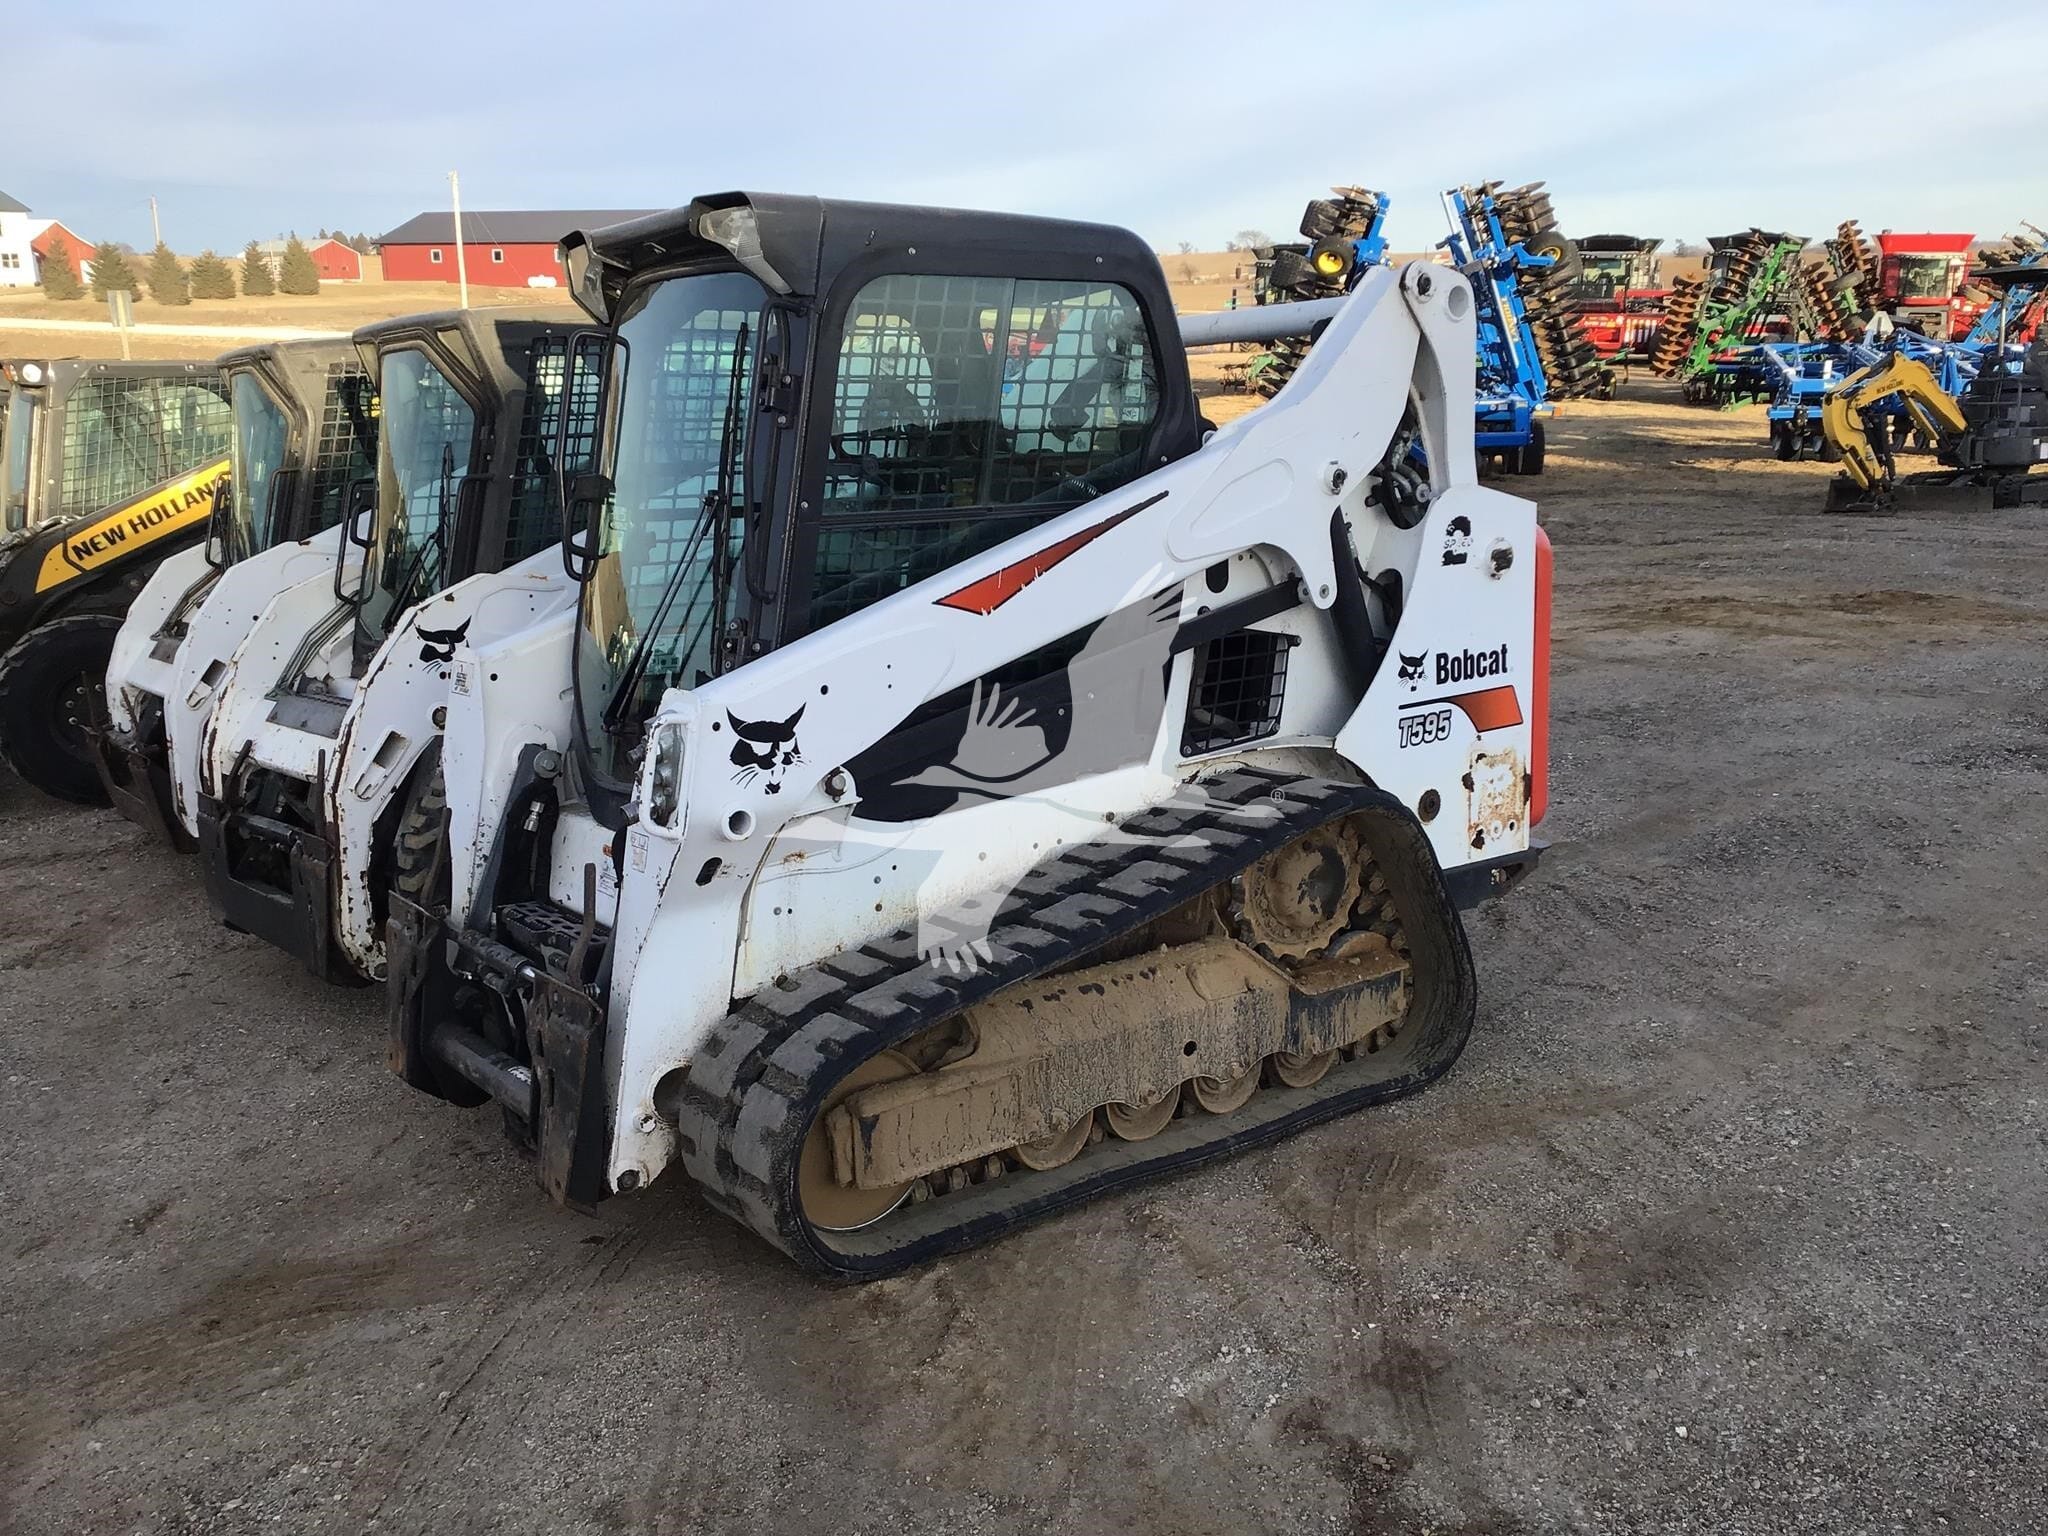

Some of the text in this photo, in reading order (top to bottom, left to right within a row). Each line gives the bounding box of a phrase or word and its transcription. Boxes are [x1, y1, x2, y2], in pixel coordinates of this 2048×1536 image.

[71, 479, 215, 561] NEW HOLLAN
[1436, 644, 1508, 685] Bobcat
[1399, 709, 1452, 748] T595
